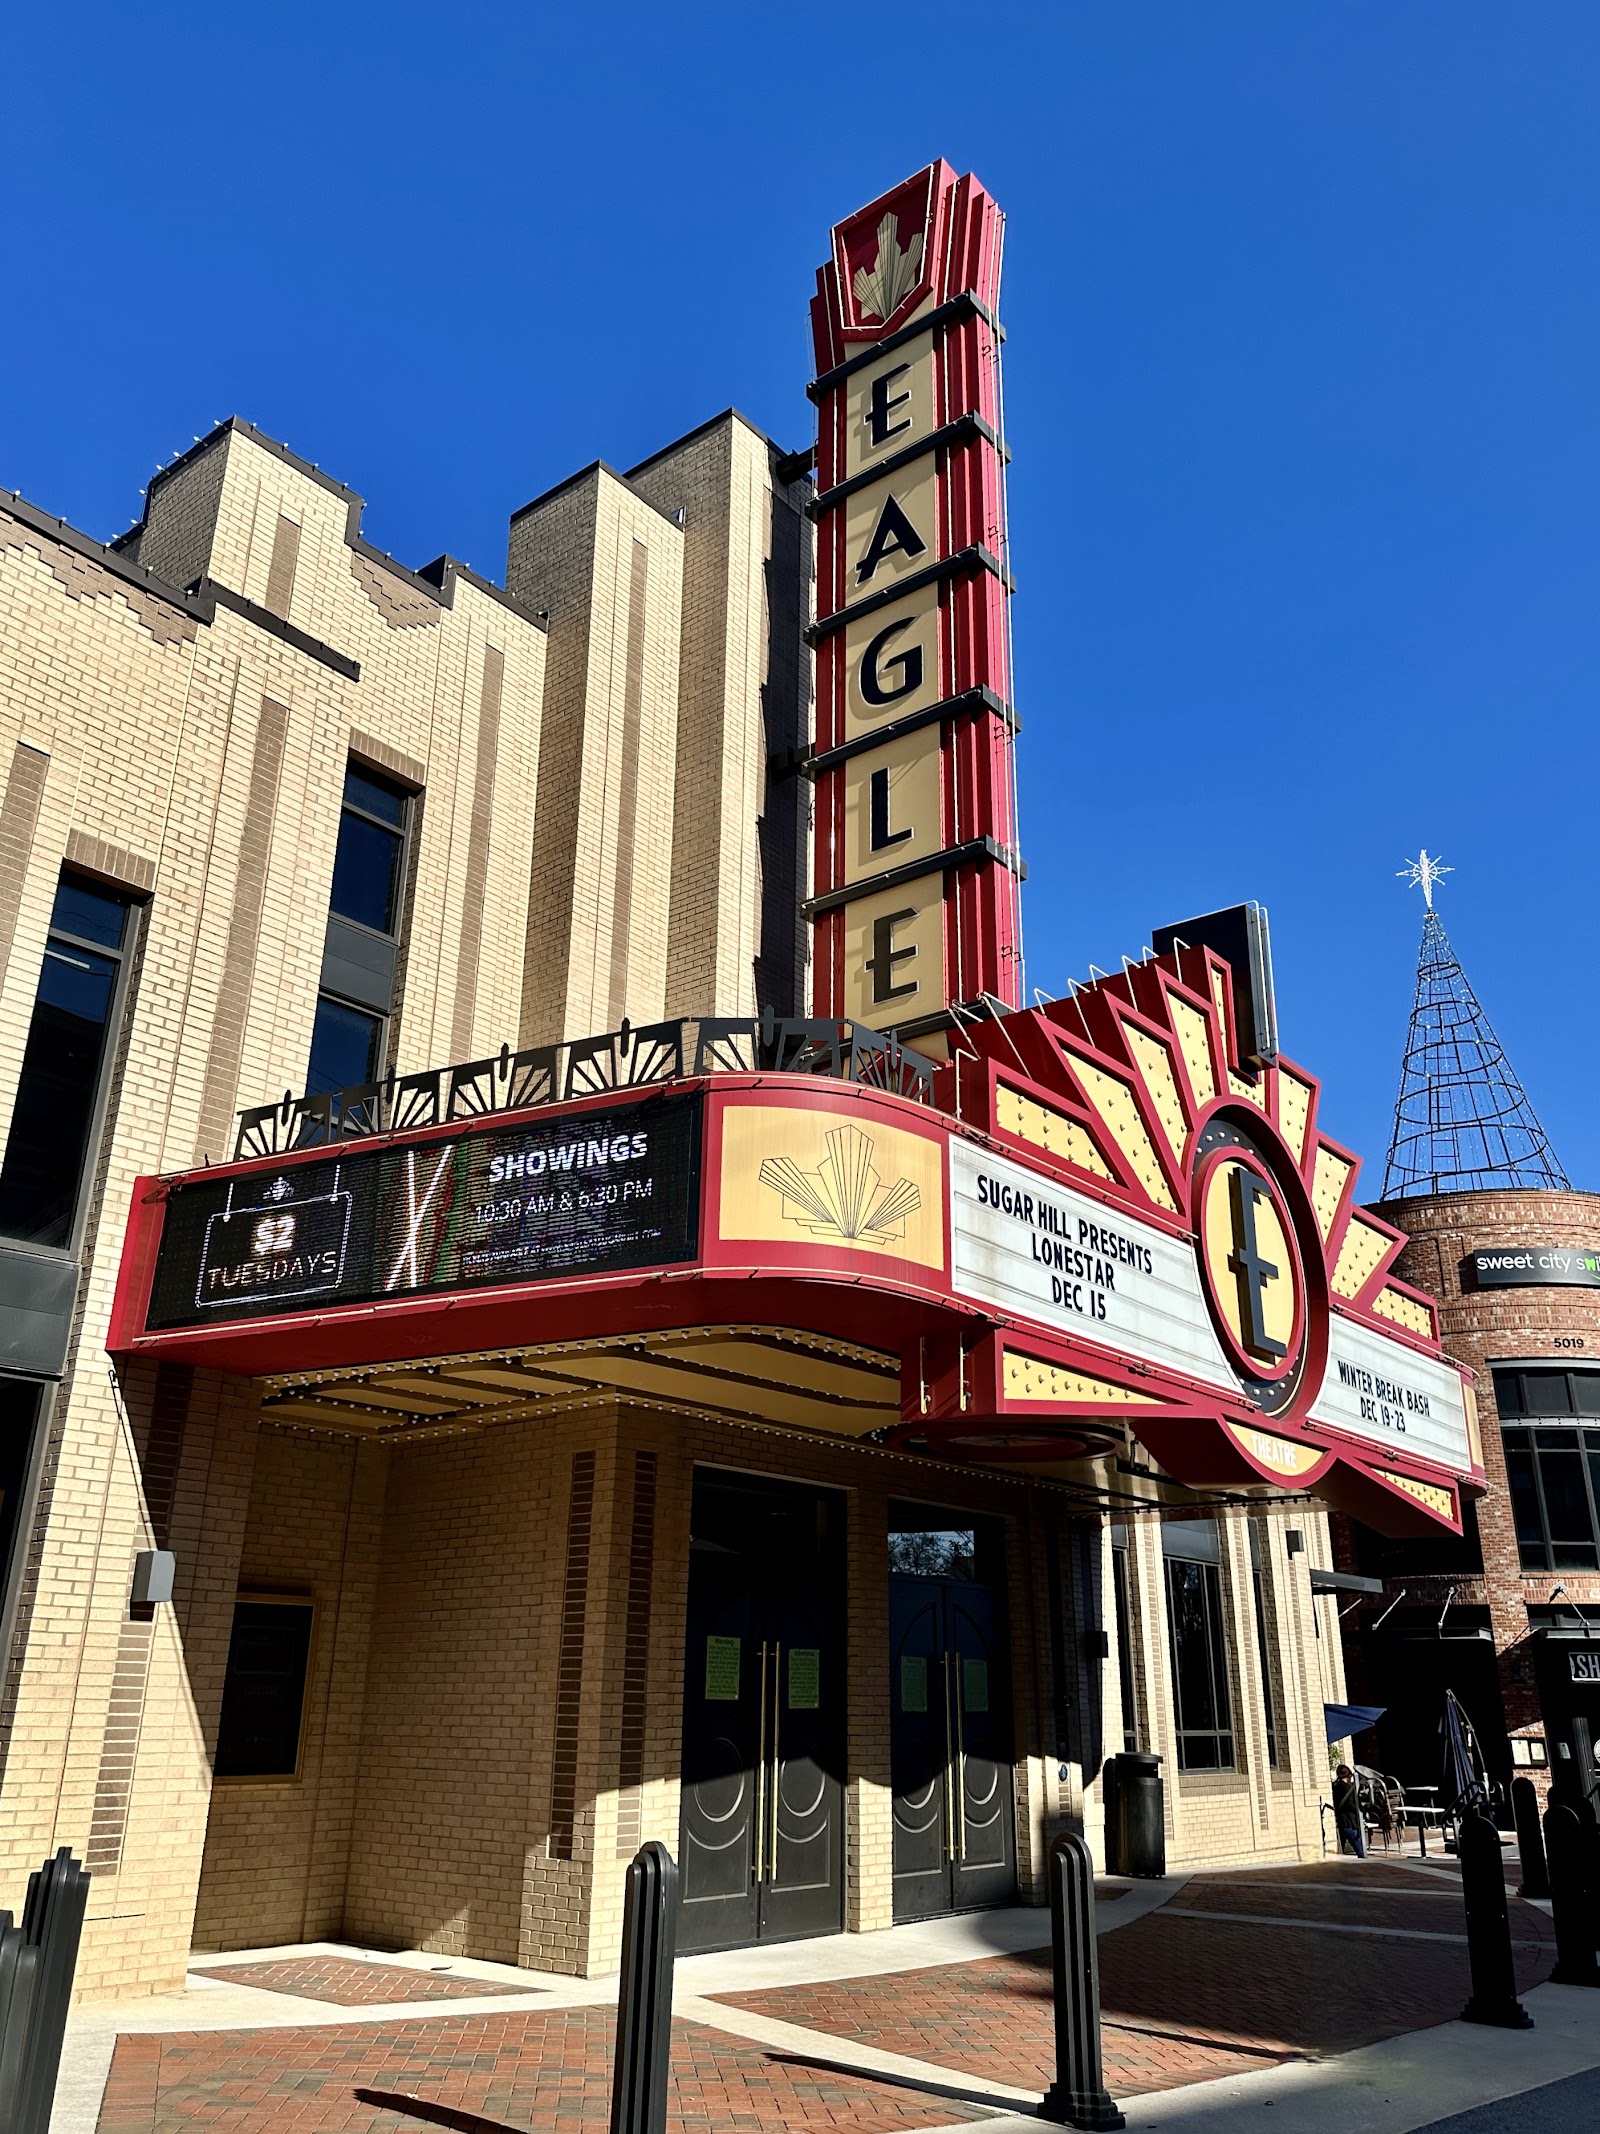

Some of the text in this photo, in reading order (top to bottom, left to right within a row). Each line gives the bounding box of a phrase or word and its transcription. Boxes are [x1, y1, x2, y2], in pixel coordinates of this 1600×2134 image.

[855, 363, 928, 1004] EAGLE
[488, 1131, 648, 1182] SHOWINGS
[475, 1198, 521, 1223] 10:30
[525, 1194, 554, 1215] AM
[559, 1191, 573, 1211] &
[623, 1178, 652, 1201] PM
[254, 1215, 295, 1255] $2
[977, 1174, 1153, 1275] SUGAR HILL PRESENTS
[208, 1250, 337, 1289] TUESDAYS
[1032, 1232, 1116, 1291] LONESTAR
[1477, 1253, 1535, 1270] sweet
[1539, 1252, 1571, 1274] city
[1052, 1275, 1106, 1320] DEC 15
[1553, 1338, 1584, 1349] 5019
[1338, 1360, 1430, 1417] WINTER BREAK BASH
[1360, 1397, 1406, 1433] DEC 19-23
[1250, 1433, 1297, 1469] THEATRE
